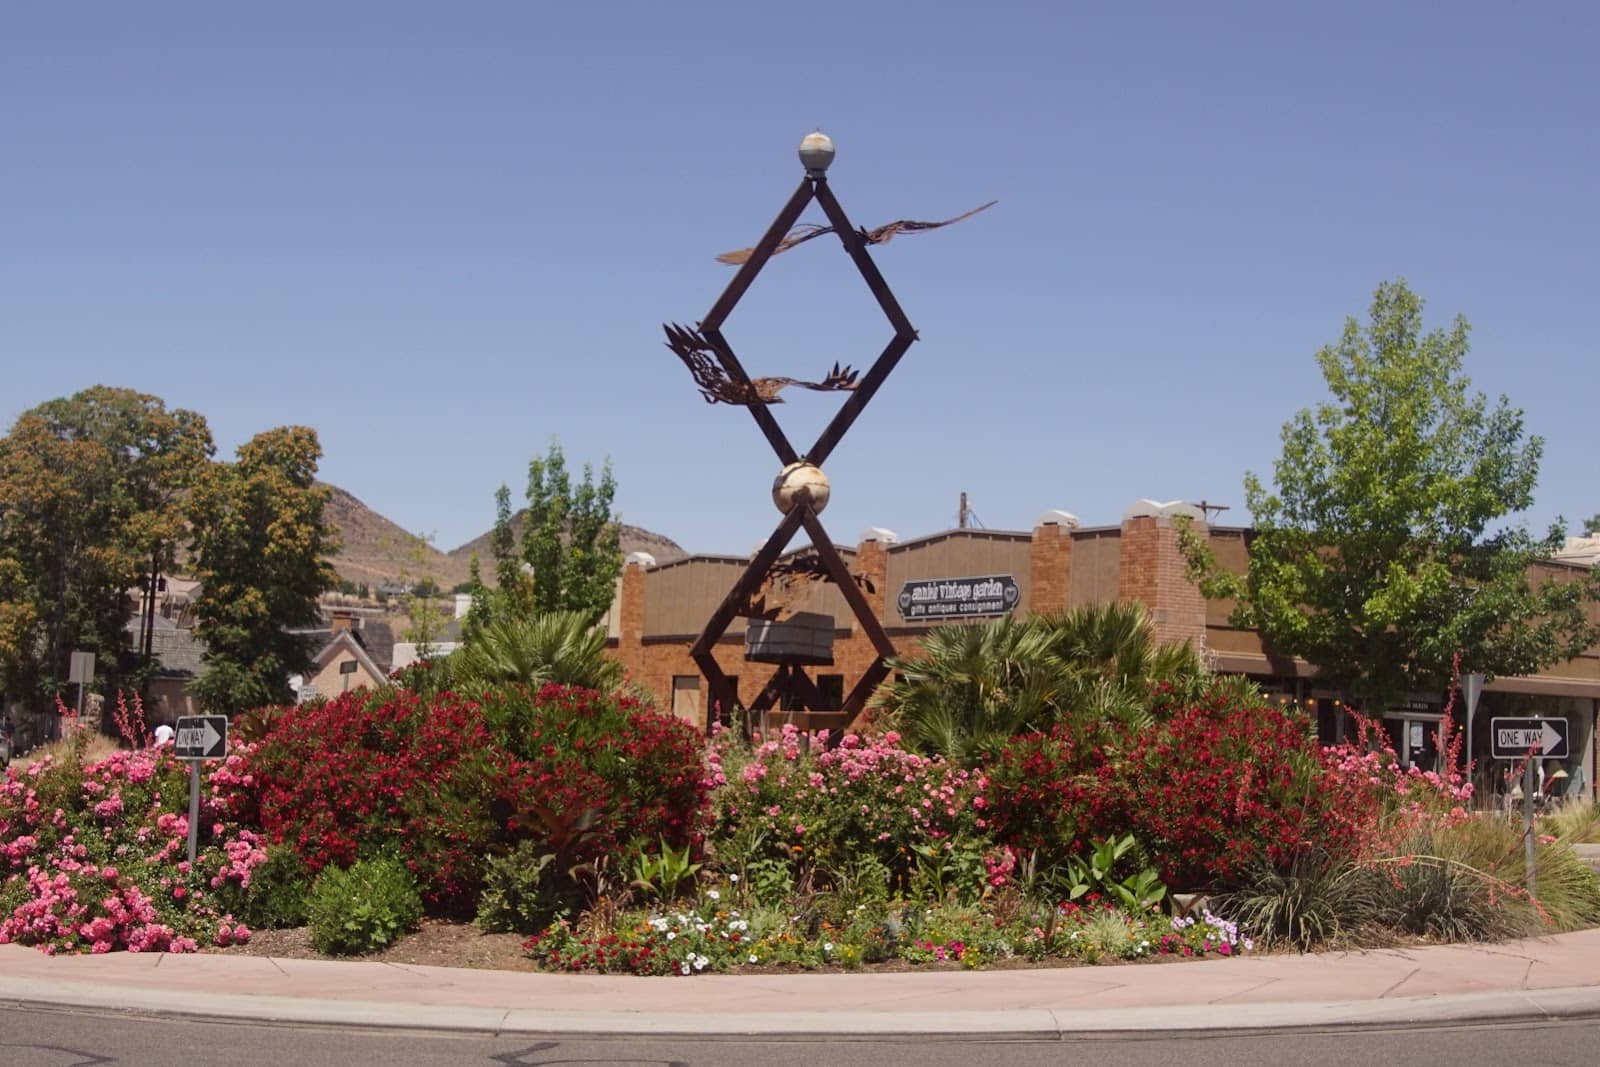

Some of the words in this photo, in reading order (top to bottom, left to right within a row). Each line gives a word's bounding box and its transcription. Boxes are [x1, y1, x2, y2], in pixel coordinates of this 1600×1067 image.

[940, 581, 972, 601] vintage
[973, 578, 1004, 601] garden
[911, 604, 926, 616] gifts
[928, 602, 957, 614] antiques
[960, 600, 1004, 613] consignment
[1501, 731, 1519, 745] ONE
[1524, 731, 1543, 745] WAY
